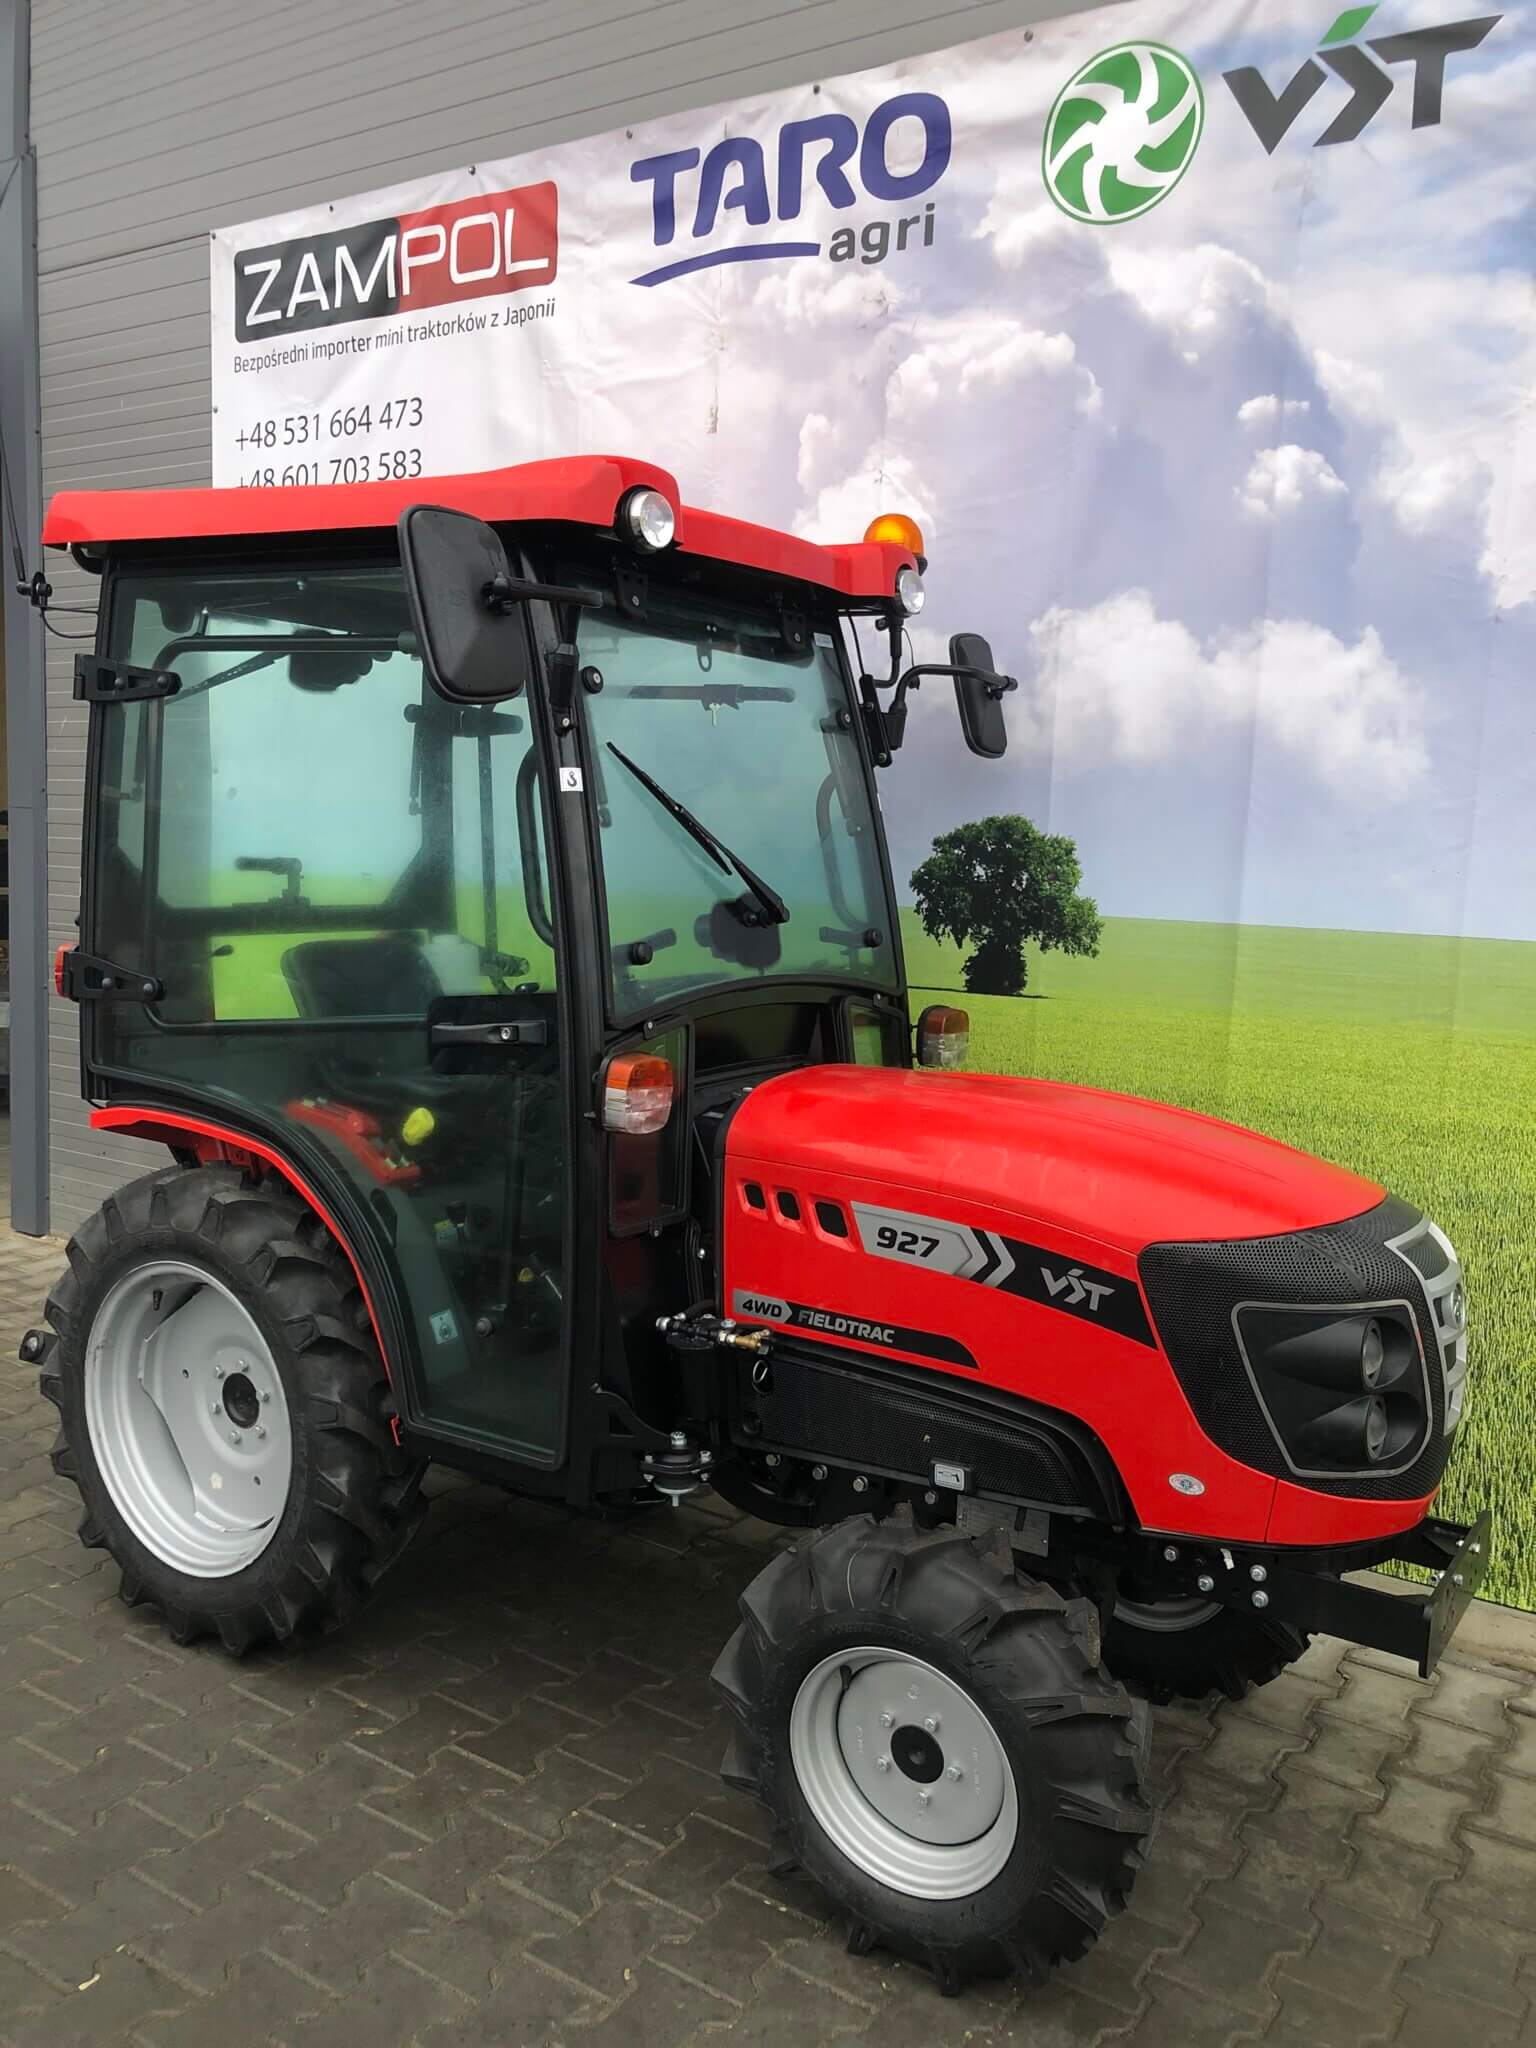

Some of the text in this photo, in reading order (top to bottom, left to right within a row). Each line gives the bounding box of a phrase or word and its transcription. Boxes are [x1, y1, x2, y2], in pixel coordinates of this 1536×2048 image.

[1222, 4, 1504, 156] VST
[630, 92, 952, 246] TARO
[828, 203, 936, 265] agri
[243, 208, 549, 327] ZAMPOL
[233, 298, 556, 374] Bezpośredni importer mini traktorków z Japonii
[235, 397, 423, 451] +48 531 664 473
[282, 462, 319, 487] 601
[329, 455, 370, 485] 703
[377, 448, 422, 481] 583
[876, 1226, 940, 1258] 927
[742, 1299, 782, 1318] 4WD
[798, 1309, 895, 1344] FIELDTRAC
